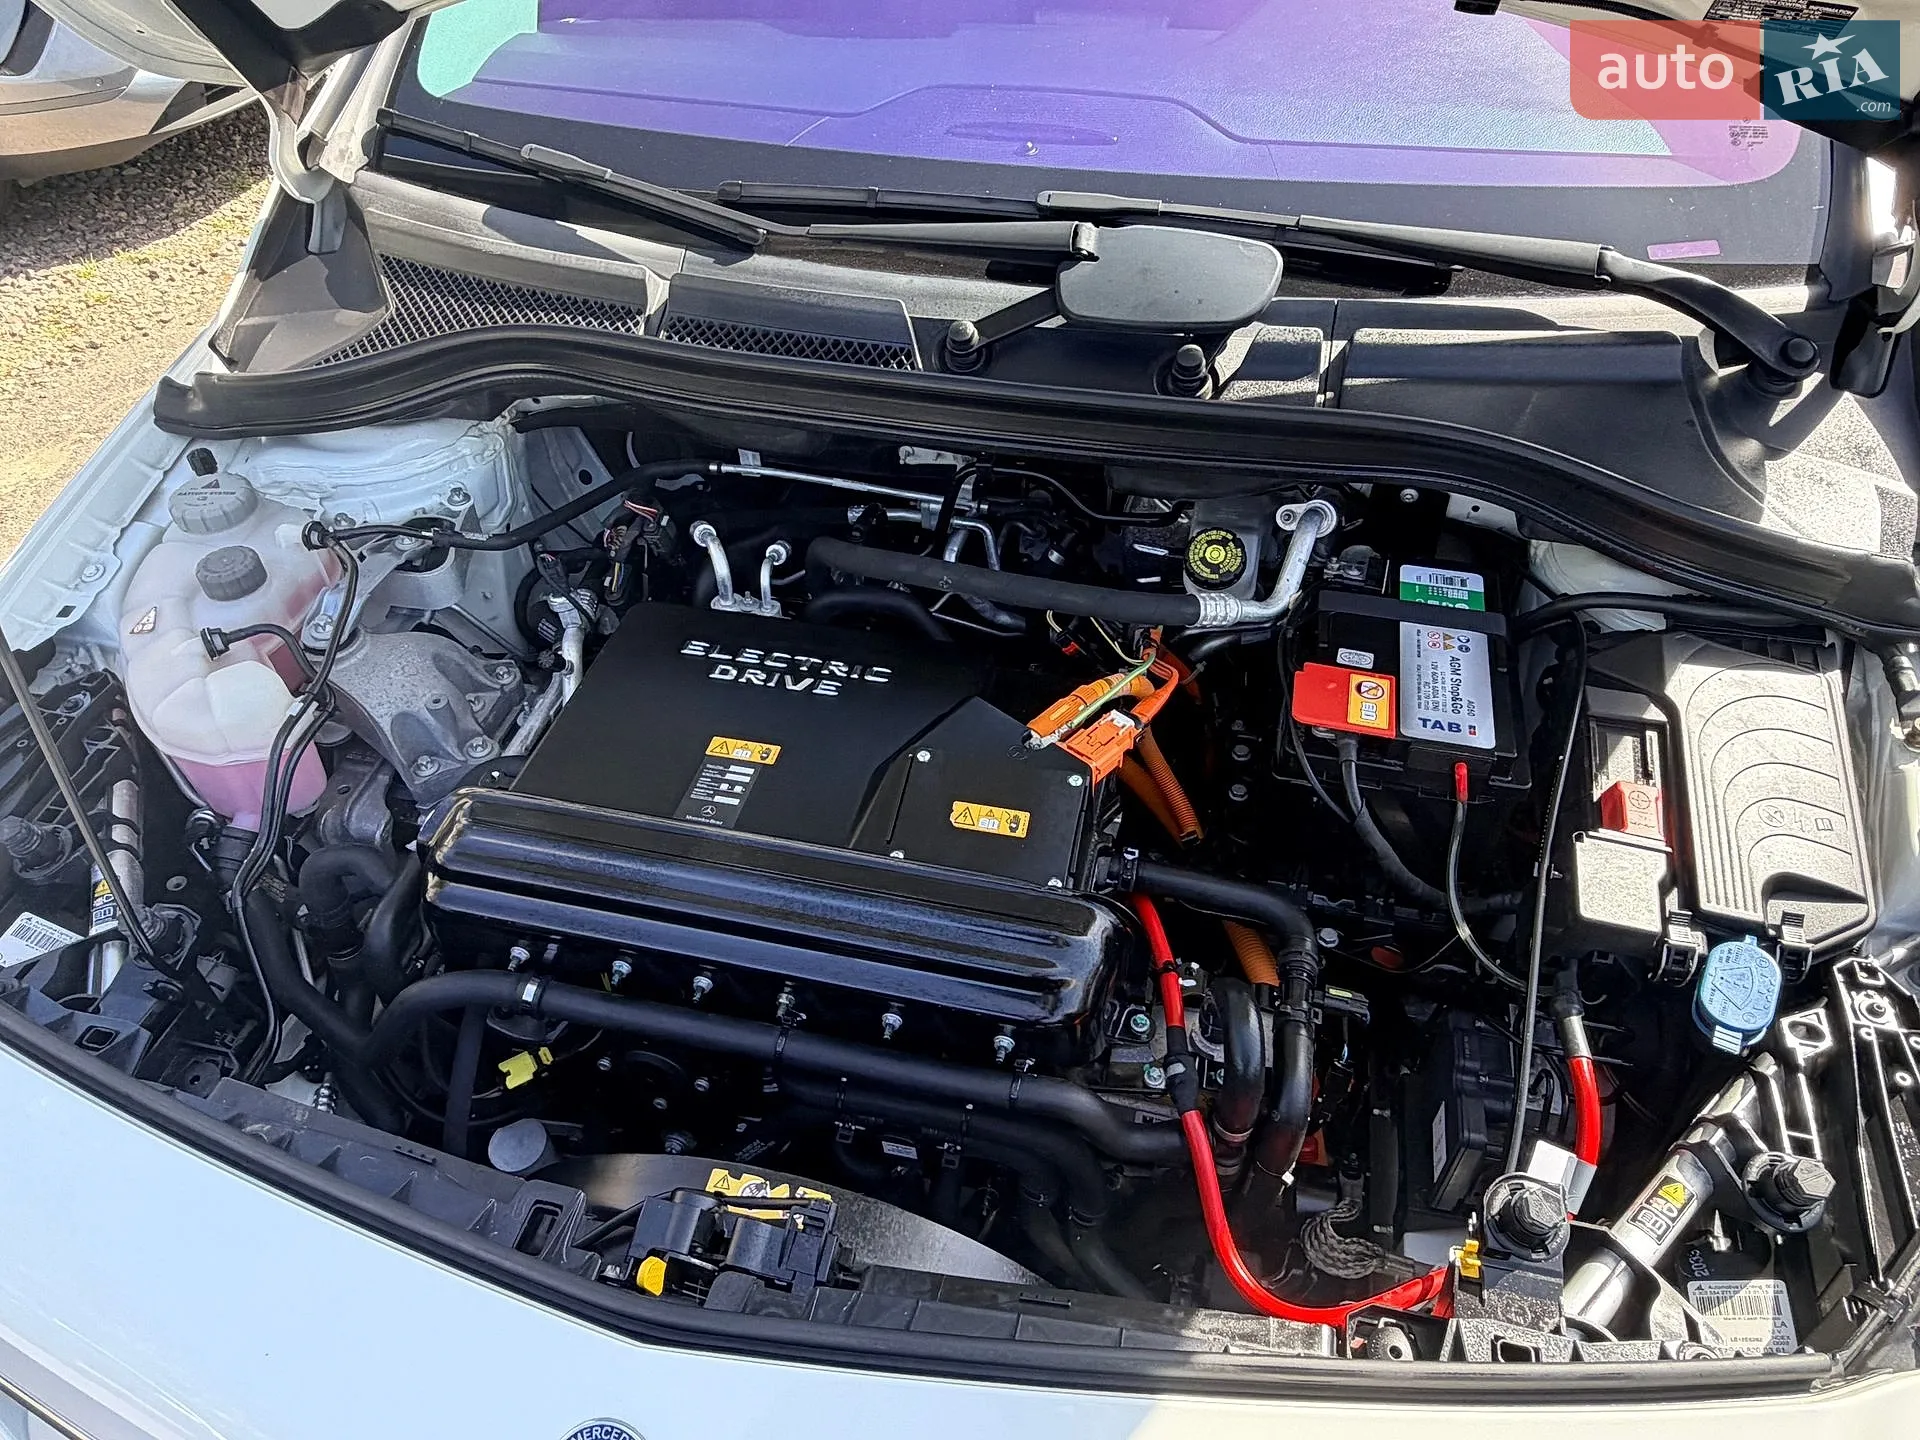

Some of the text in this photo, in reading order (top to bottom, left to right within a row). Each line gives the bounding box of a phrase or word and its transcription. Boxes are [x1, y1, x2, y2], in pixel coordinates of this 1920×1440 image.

[680, 640, 893, 683] ELECTRIC
[709, 664, 843, 696] DRIVE
[1448, 655, 1463, 715] AGM Stop&Go
[1418, 717, 1462, 733] TAB
